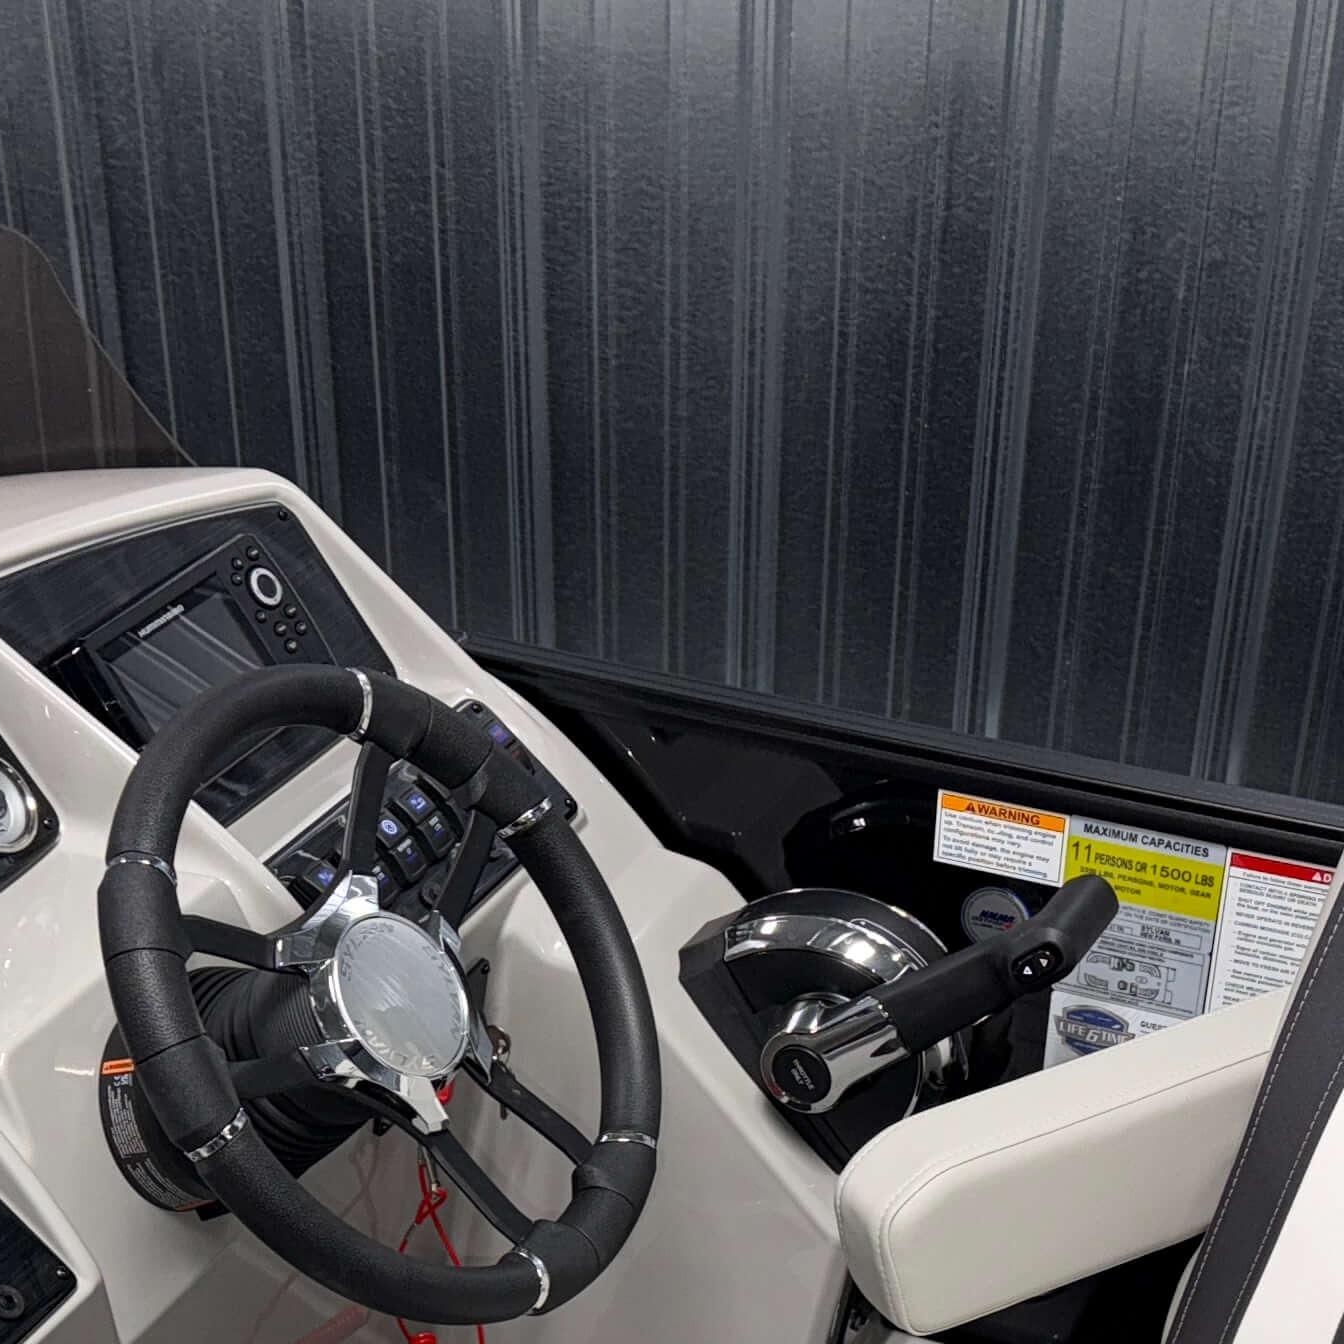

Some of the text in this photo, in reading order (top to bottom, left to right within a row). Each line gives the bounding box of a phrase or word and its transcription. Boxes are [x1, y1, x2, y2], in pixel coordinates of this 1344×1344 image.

[978, 804, 1041, 826] WARNING
[1083, 823, 1209, 858] MAXIMUM CAPACITIES
[1072, 841, 1092, 863] 11
[1094, 852, 1134, 873] PERSONS
[1135, 862, 1147, 874] OR
[1150, 864, 1193, 883] 1500
[1195, 871, 1215, 888] LBS
[1059, 1020, 1087, 1036] LIFE
[1084, 1028, 1098, 1041] 6
